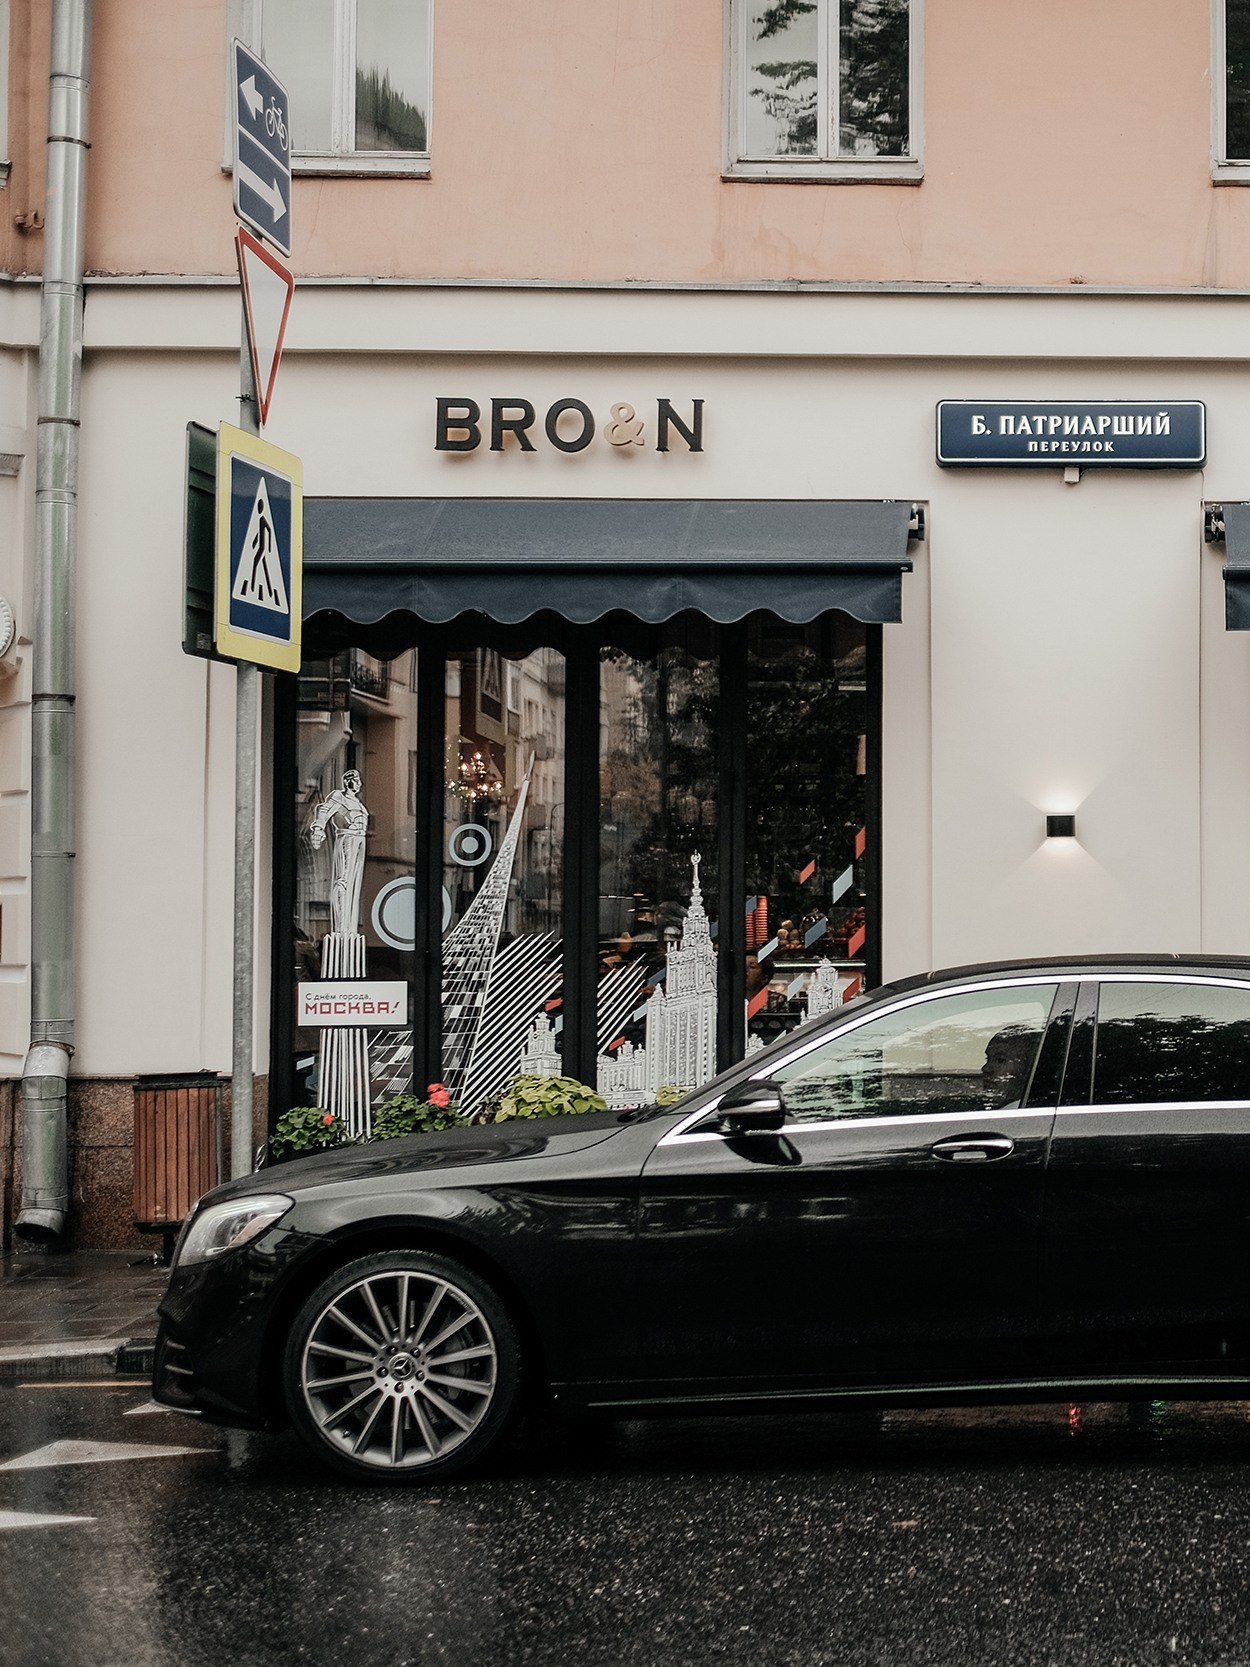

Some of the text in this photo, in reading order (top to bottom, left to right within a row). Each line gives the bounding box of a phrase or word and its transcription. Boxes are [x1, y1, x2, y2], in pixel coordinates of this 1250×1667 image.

[434, 397, 704, 453] BRO&N
[972, 412, 1171, 435] Б. ПАТРИАРШИЙ
[1028, 441, 1114, 452] ПЕРЕУЛОК
[339, 993, 372, 1001] города,
[305, 1001, 400, 1014] МОСКВА!
